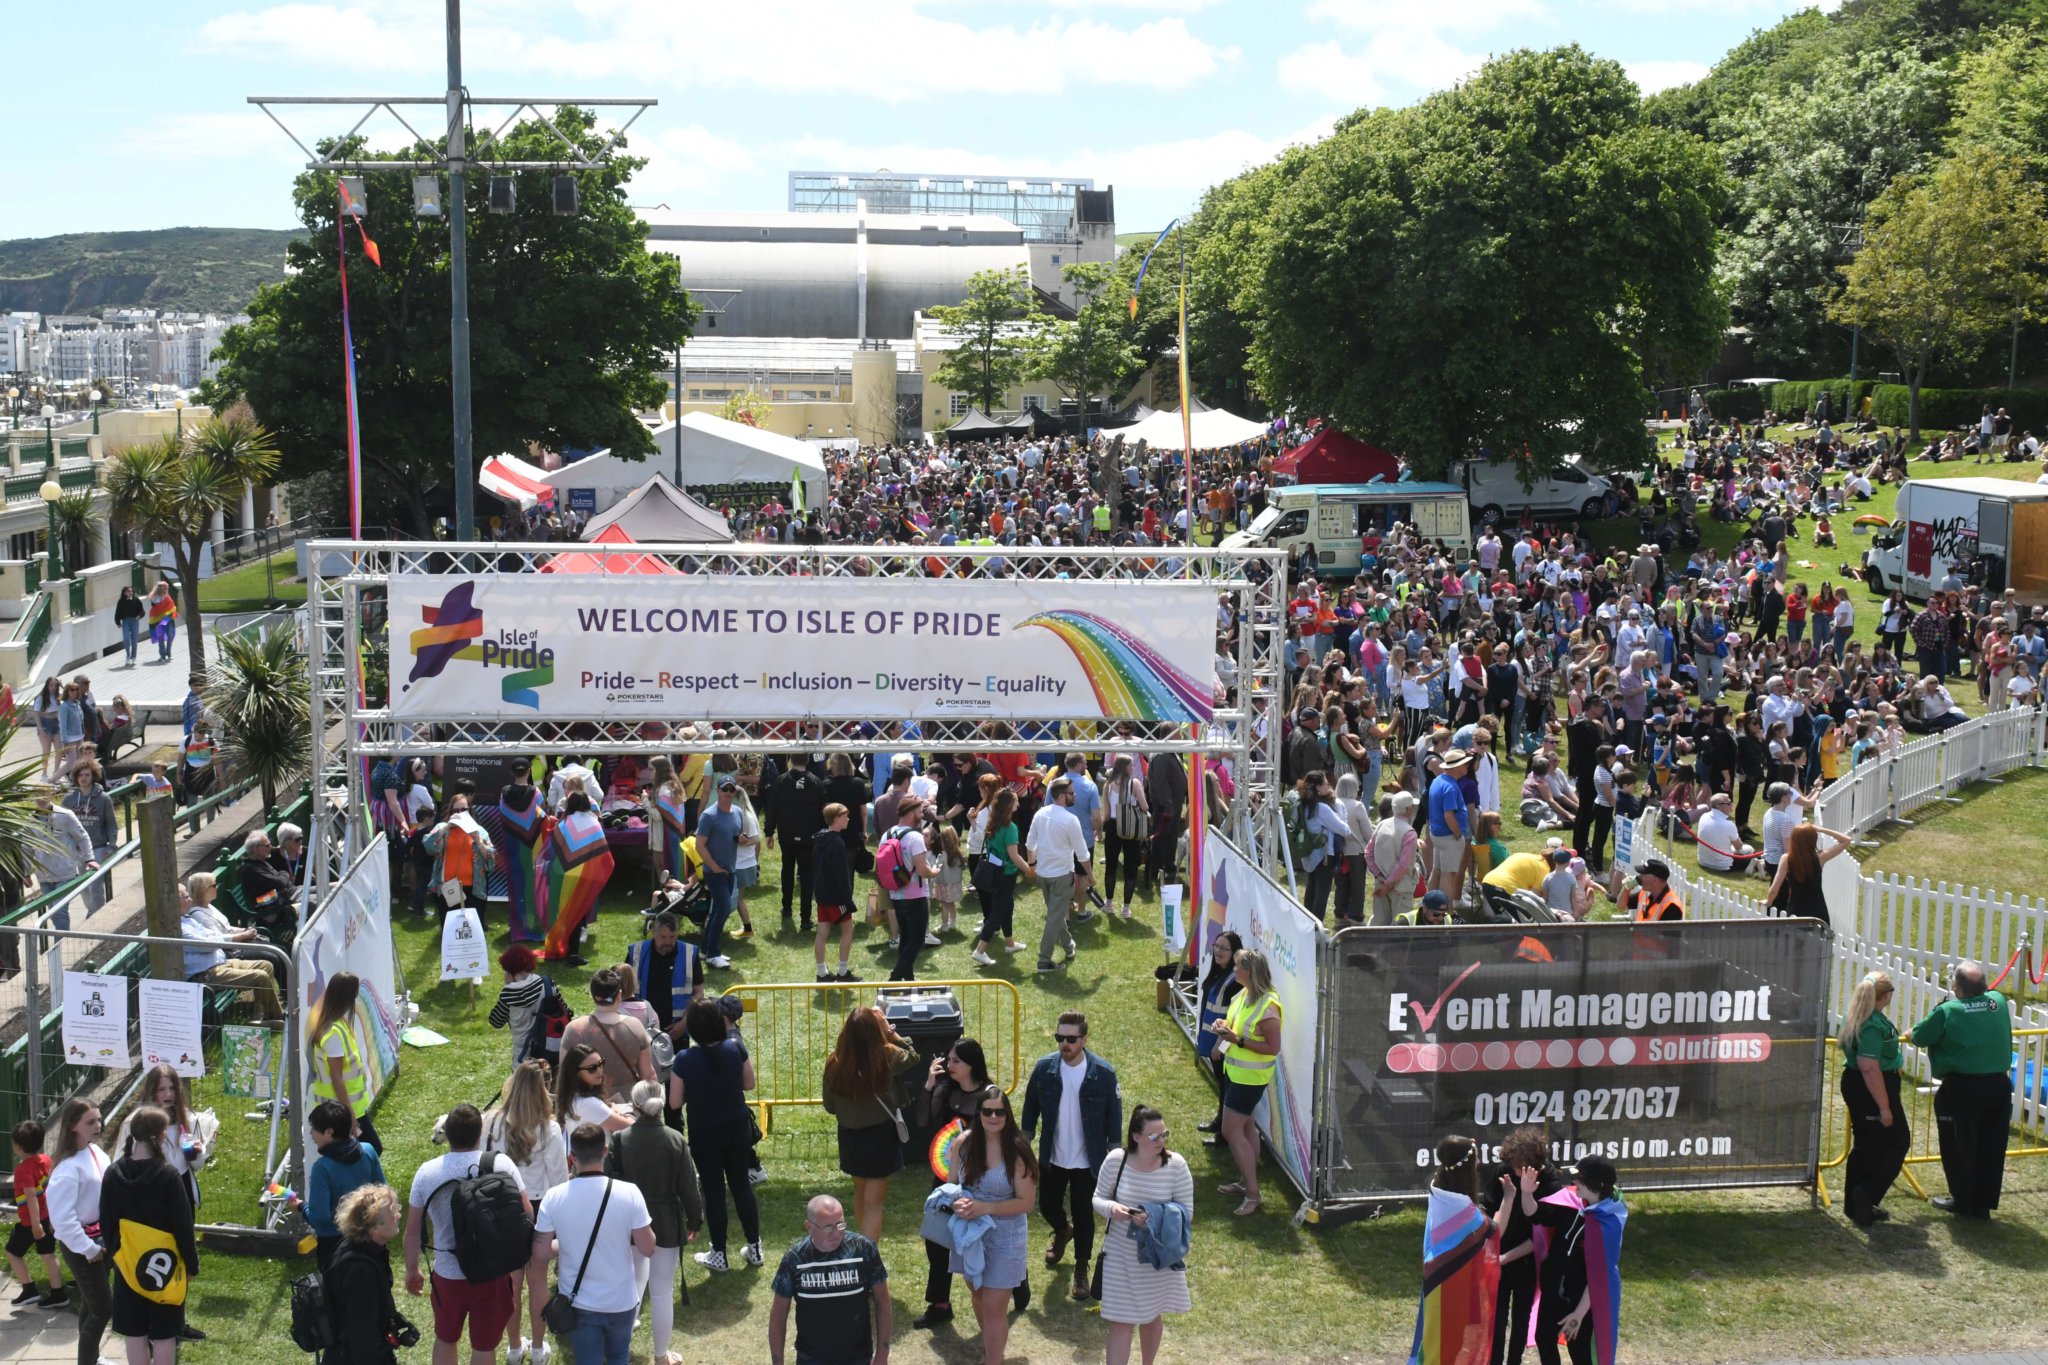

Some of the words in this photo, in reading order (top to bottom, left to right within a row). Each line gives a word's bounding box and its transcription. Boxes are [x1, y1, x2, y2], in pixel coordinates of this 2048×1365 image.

[500, 628, 528, 645] Isle
[529, 629, 538, 639] of
[577, 608, 737, 633] WELCOME
[748, 609, 788, 633] TO
[797, 610, 855, 635] ISLE
[864, 611, 904, 635] OF
[913, 611, 1000, 637] PRIDE
[482, 639, 554, 669] Pride
[581, 671, 635, 690] Pride
[658, 671, 739, 693] Respect
[762, 672, 852, 691] Inclusion
[875, 672, 964, 695] Diversity
[985, 674, 1067, 696] Equality
[456, 756, 503, 766] International
[1274, 932, 1297, 978] Pride
[1521, 985, 1771, 1031] Management
[1648, 1037, 1762, 1062] Solutions
[1473, 1090, 1566, 1126] 01624
[1572, 1086, 1680, 1122] 827037
[145, 1252, 172, 1288] JD
[801, 1272, 827, 1288] SANTA
[828, 1269, 859, 1286] MONICA
